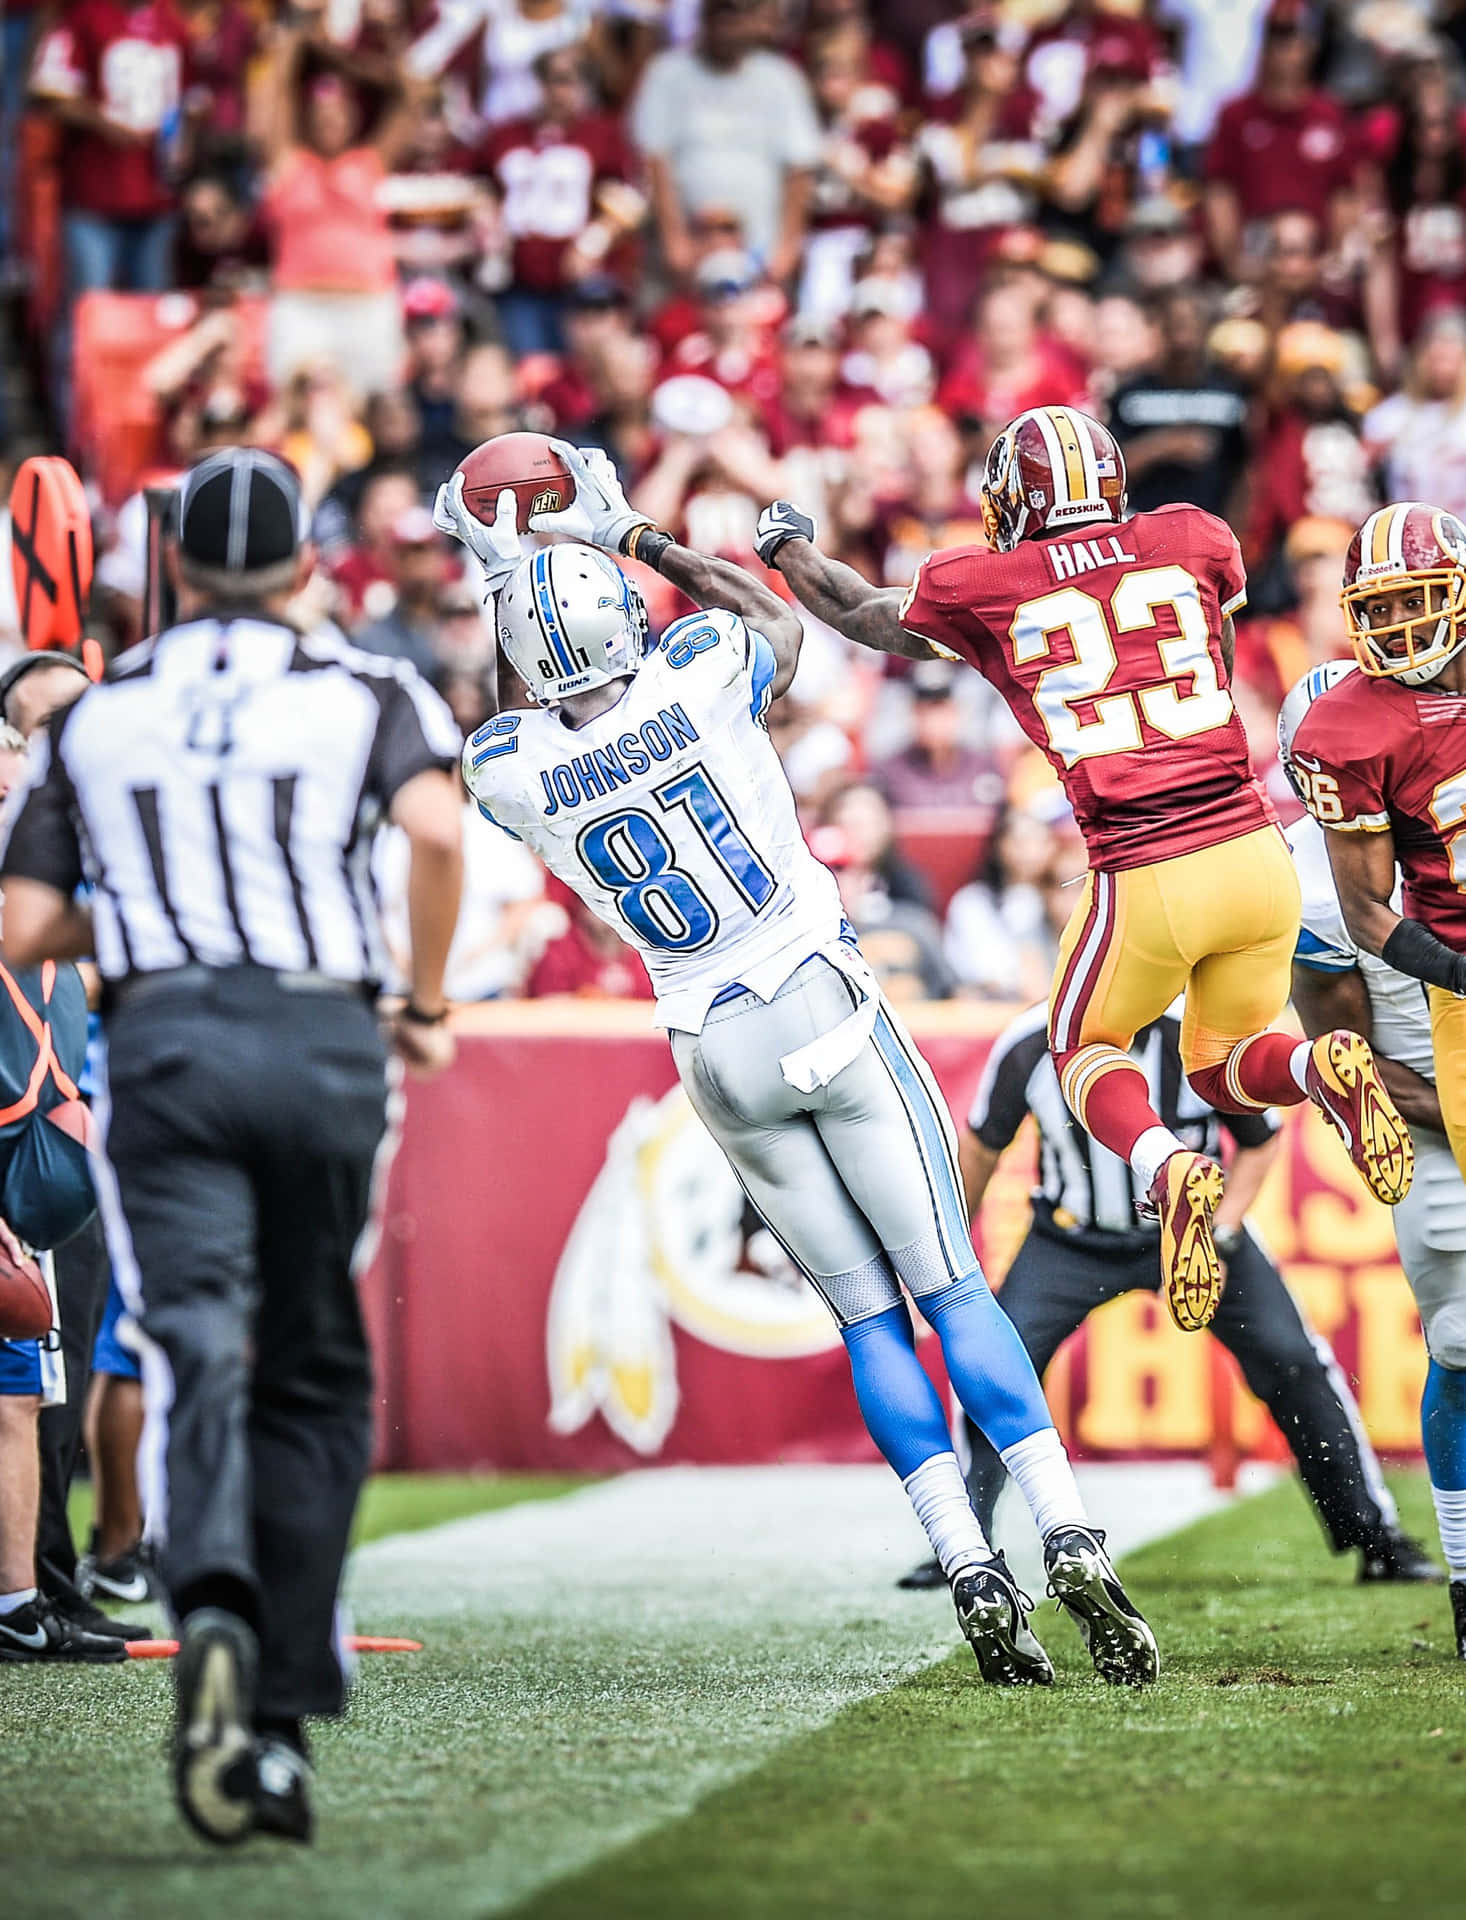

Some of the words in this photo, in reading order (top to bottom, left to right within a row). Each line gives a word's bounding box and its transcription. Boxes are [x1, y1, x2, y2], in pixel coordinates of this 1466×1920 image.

[1055, 503, 1104, 517] REDSKINS
[1047, 536, 1136, 581] HALL
[537, 647, 592, 679] 81
[660, 613, 720, 669] 81
[1008, 563, 1235, 769] 23
[557, 675, 591, 692] LIONS
[472, 716, 521, 772] 81
[540, 702, 700, 816] JOHNSON
[575, 760, 778, 953] 81
